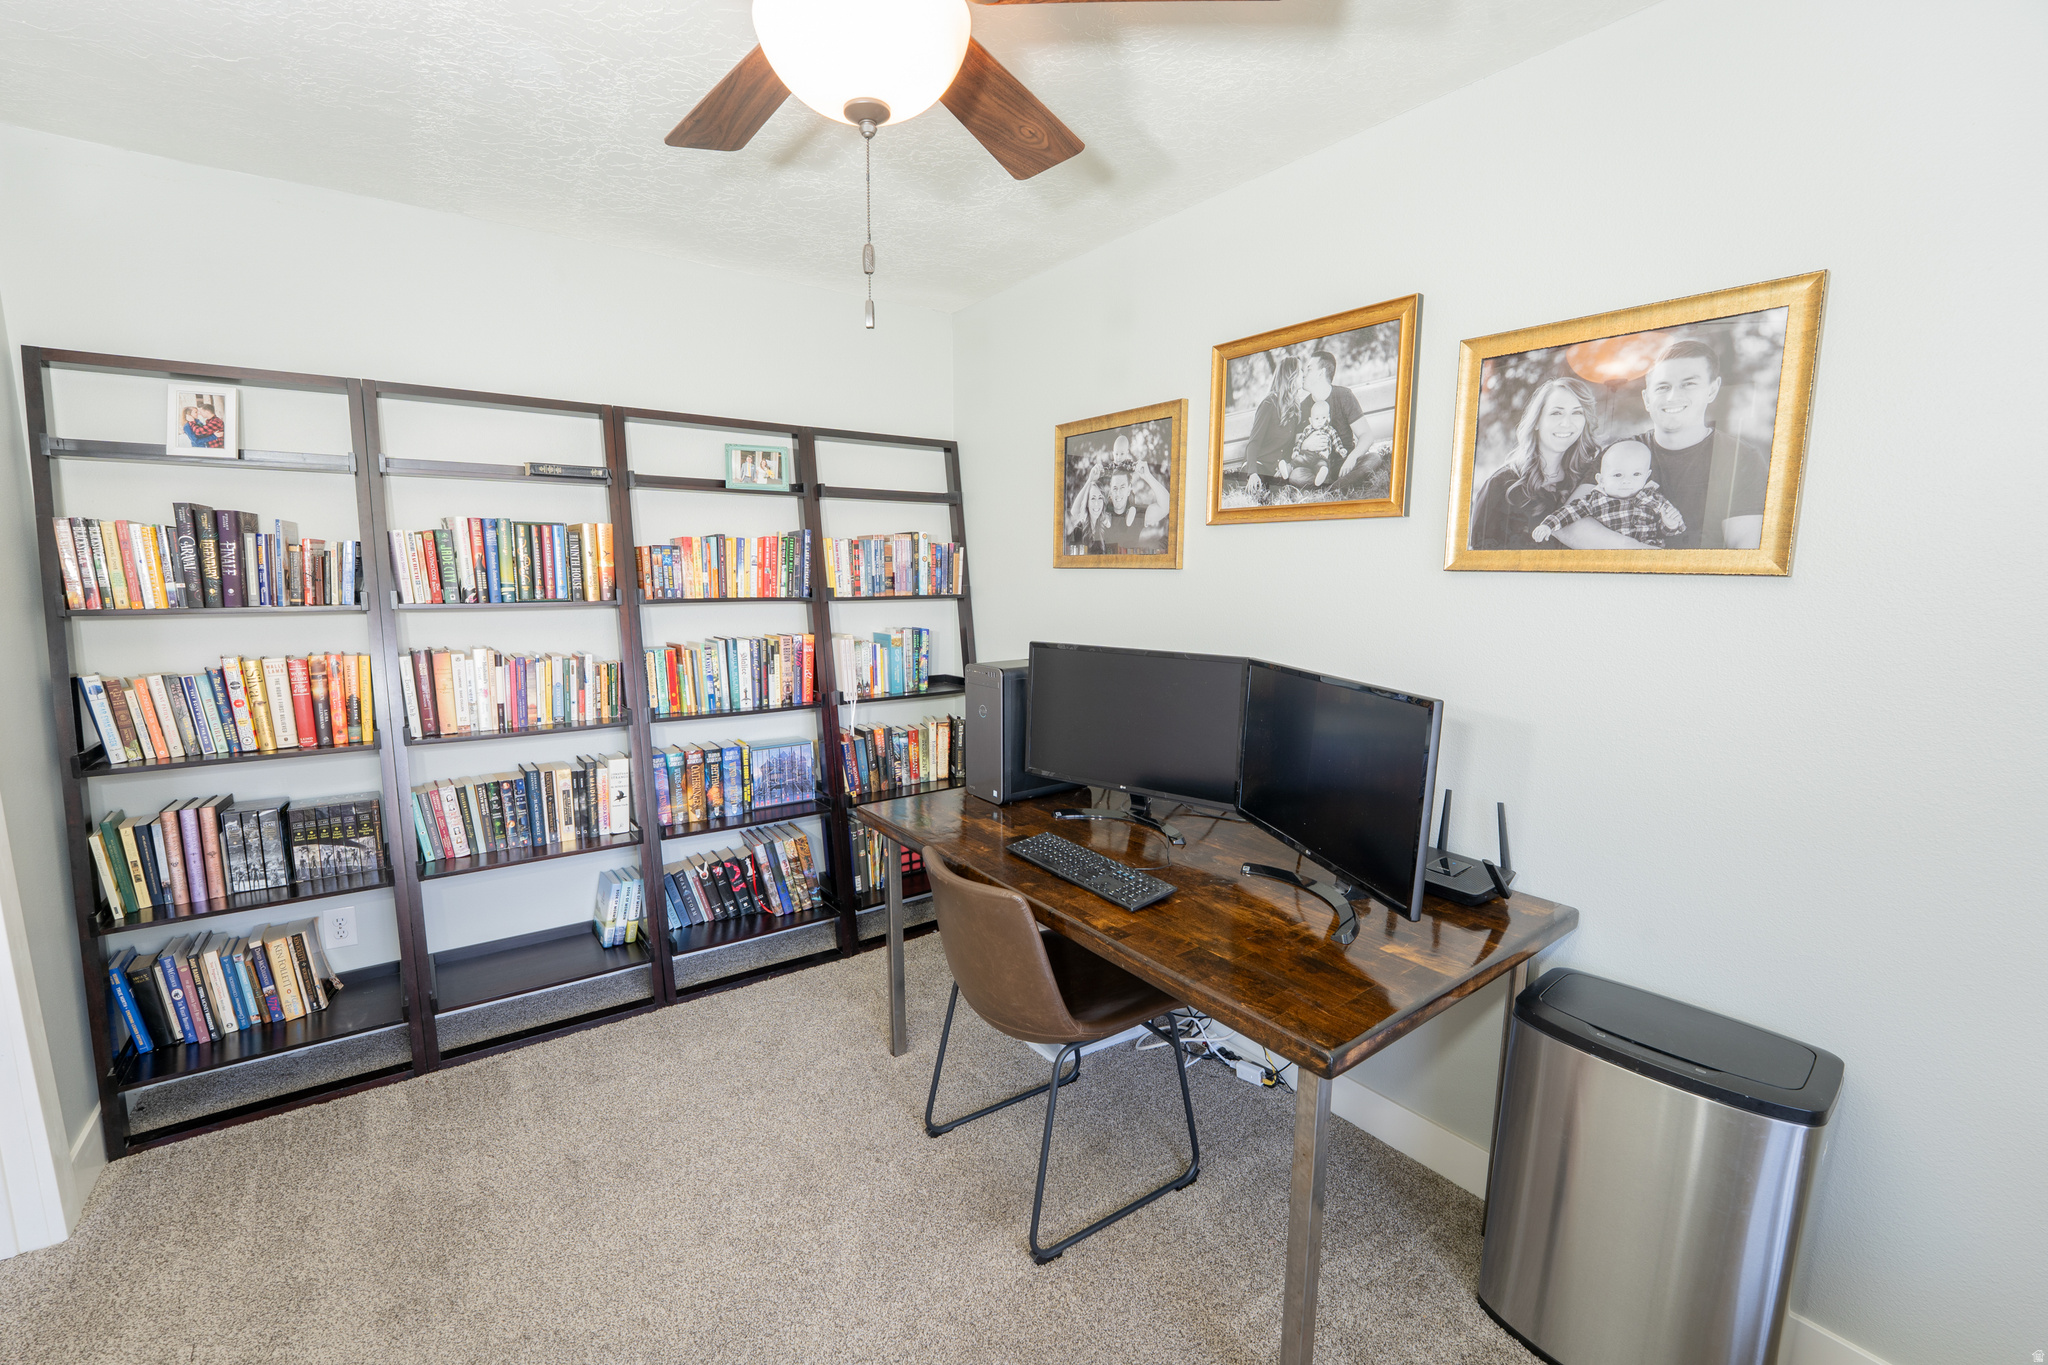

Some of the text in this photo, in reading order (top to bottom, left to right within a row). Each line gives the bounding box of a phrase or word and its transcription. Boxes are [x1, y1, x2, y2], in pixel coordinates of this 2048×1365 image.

[178, 535, 197, 572] CARAVAL
[200, 539, 220, 580] LEGENDARY
[220, 540, 236, 576] FINALE
[440, 545, 457, 583] JADE CITY
[570, 544, 581, 590] NINTH HOUSE
[213, 677, 225, 705] Matt Haig
[244, 668, 262, 698] Silva
[141, 695, 150, 707] JONES
[205, 698, 223, 743] RADAR GIRLS
[222, 722, 231, 740] LIBRARY
[279, 712, 288, 733] BELIEVED
[711, 764, 719, 787] RHYTHM
[729, 761, 737, 777] WIND
[690, 765, 703, 808] OATHBRINGER
[730, 786, 738, 804] TRUTH
[686, 896, 698, 917] STORM
[254, 947, 263, 960] DAVID
[273, 943, 292, 988] KEN FOLLETT
[189, 958, 201, 985] DAVE RAMSEY
[267, 996, 280, 1011] 1776
